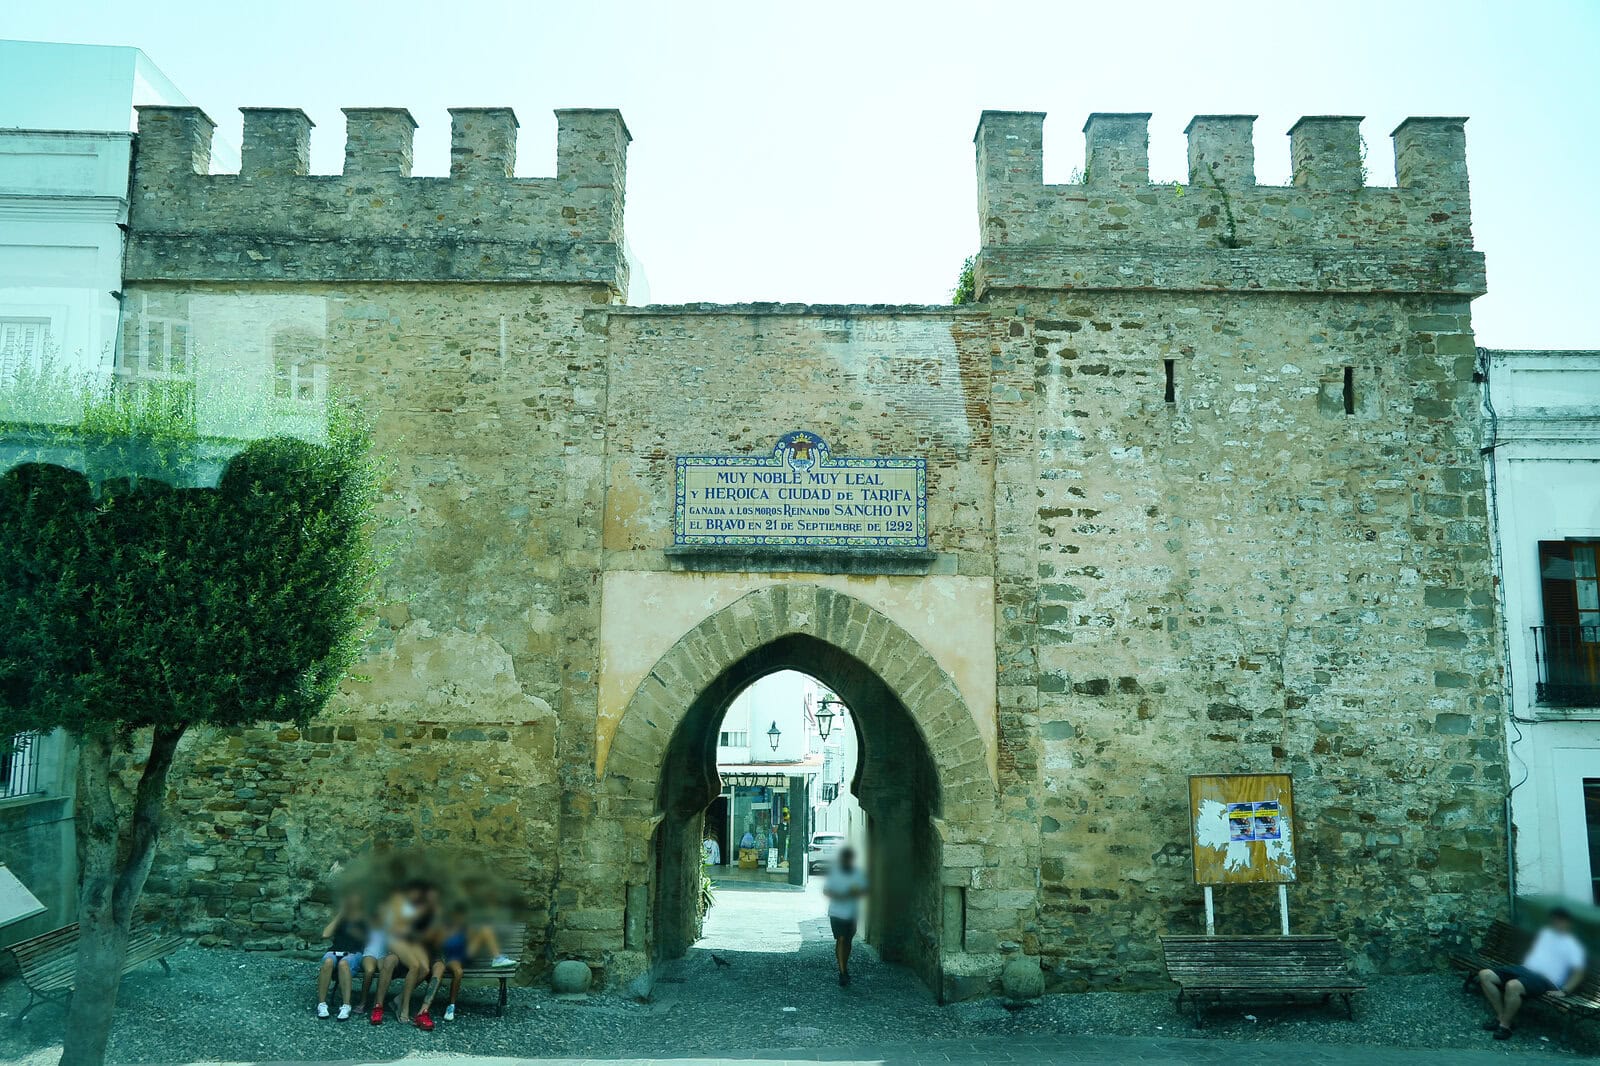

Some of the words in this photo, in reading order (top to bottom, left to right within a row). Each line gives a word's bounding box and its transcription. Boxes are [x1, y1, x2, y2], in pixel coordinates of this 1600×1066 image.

[717, 472, 748, 484] MUY
[753, 472, 802, 485] NOBLE
[808, 472, 840, 485] MUY
[846, 473, 884, 485] LEAL
[690, 491, 699, 499] Y
[705, 488, 770, 501] HEROICA
[778, 488, 831, 500] CIUDAD
[837, 492, 854, 500] DE
[861, 489, 911, 502] TARIFA
[689, 507, 726, 515] GANADA
[729, 507, 735, 515] A
[737, 507, 753, 515] LOS
[755, 507, 782, 516] MOROS
[834, 504, 892, 516] SANCHO
[897, 505, 912, 516] IV
[690, 521, 702, 530] EL
[706, 519, 745, 531] BRAVO
[748, 522, 762, 530] EN
[765, 519, 777, 530] 21
[781, 522, 793, 530] DE
[867, 523, 880, 531] DE
[886, 521, 913, 532] 1292
[719, 771, 784, 787] RUJILLO
